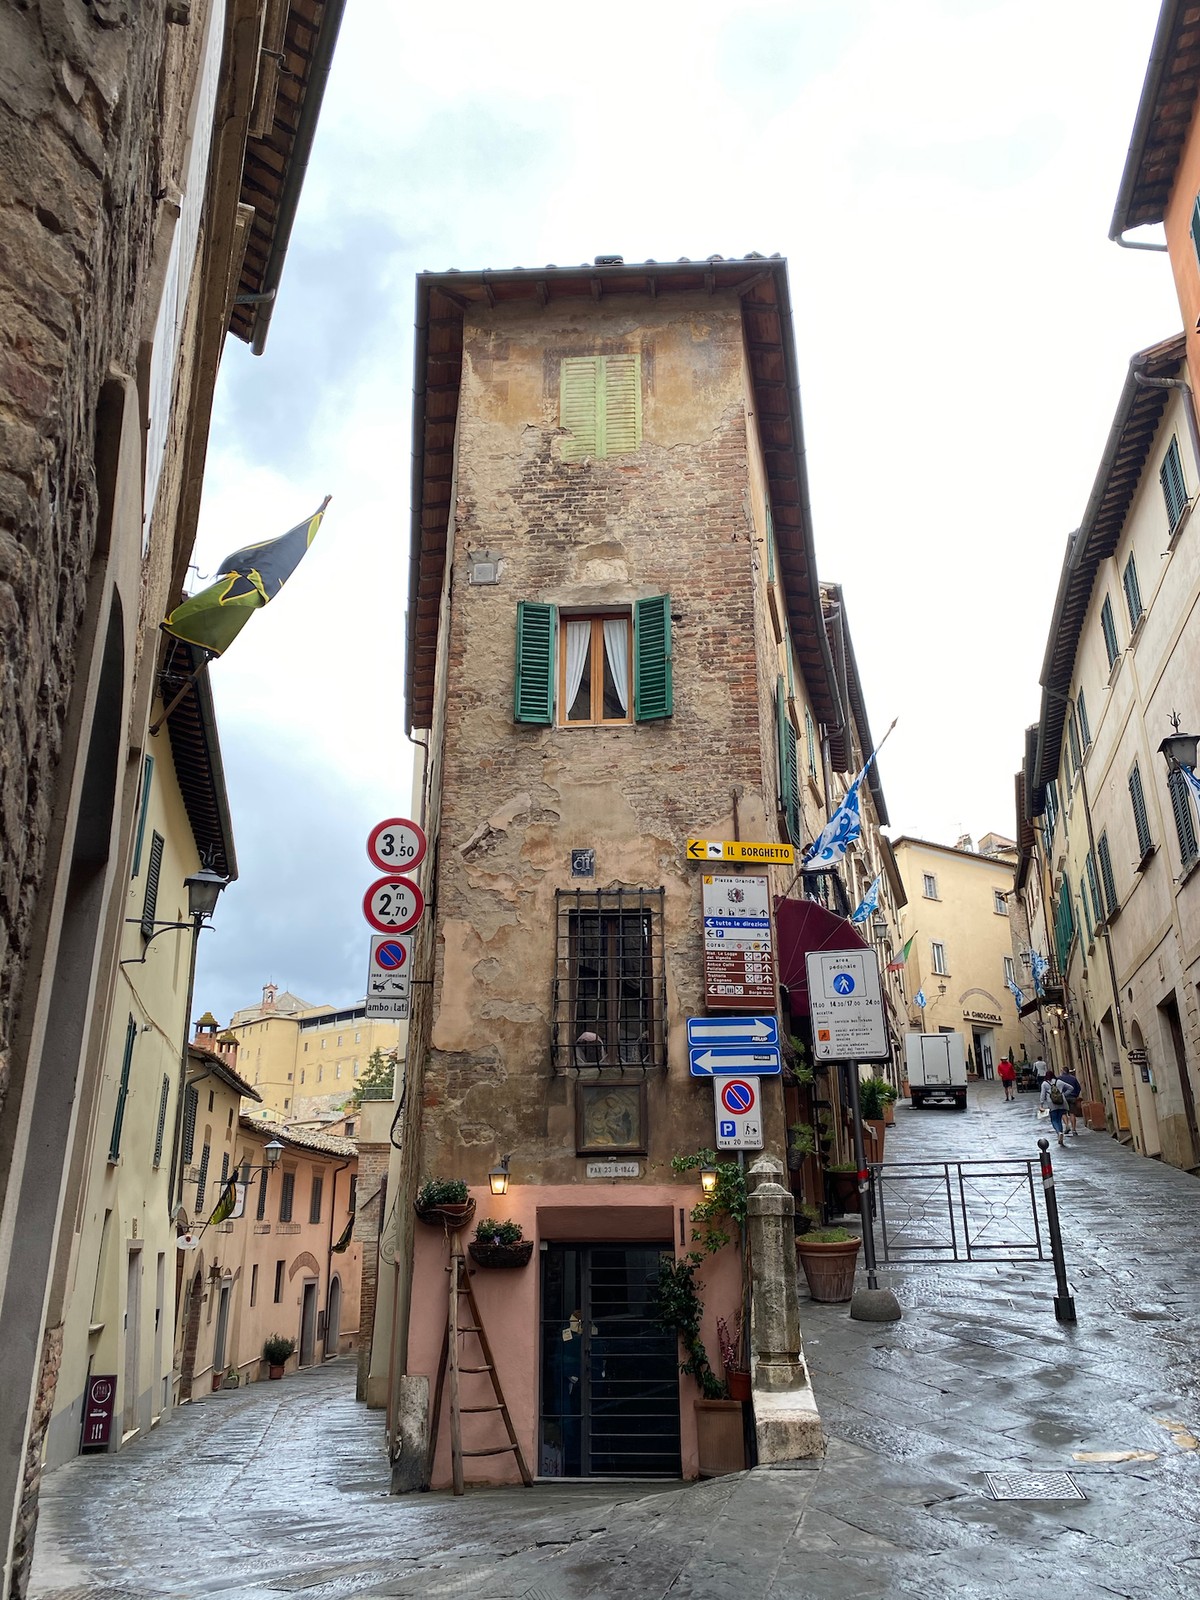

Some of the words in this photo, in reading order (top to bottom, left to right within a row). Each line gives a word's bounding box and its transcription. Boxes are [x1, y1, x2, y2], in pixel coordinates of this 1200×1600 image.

[400, 834, 405, 844] t
[727, 846, 735, 856] IL
[741, 847, 790, 858] BORGHETTO
[367, 1002, 389, 1011] ambo
[393, 1003, 408, 1012] lati
[971, 1011, 1002, 1021] CHIOCCIOLA
